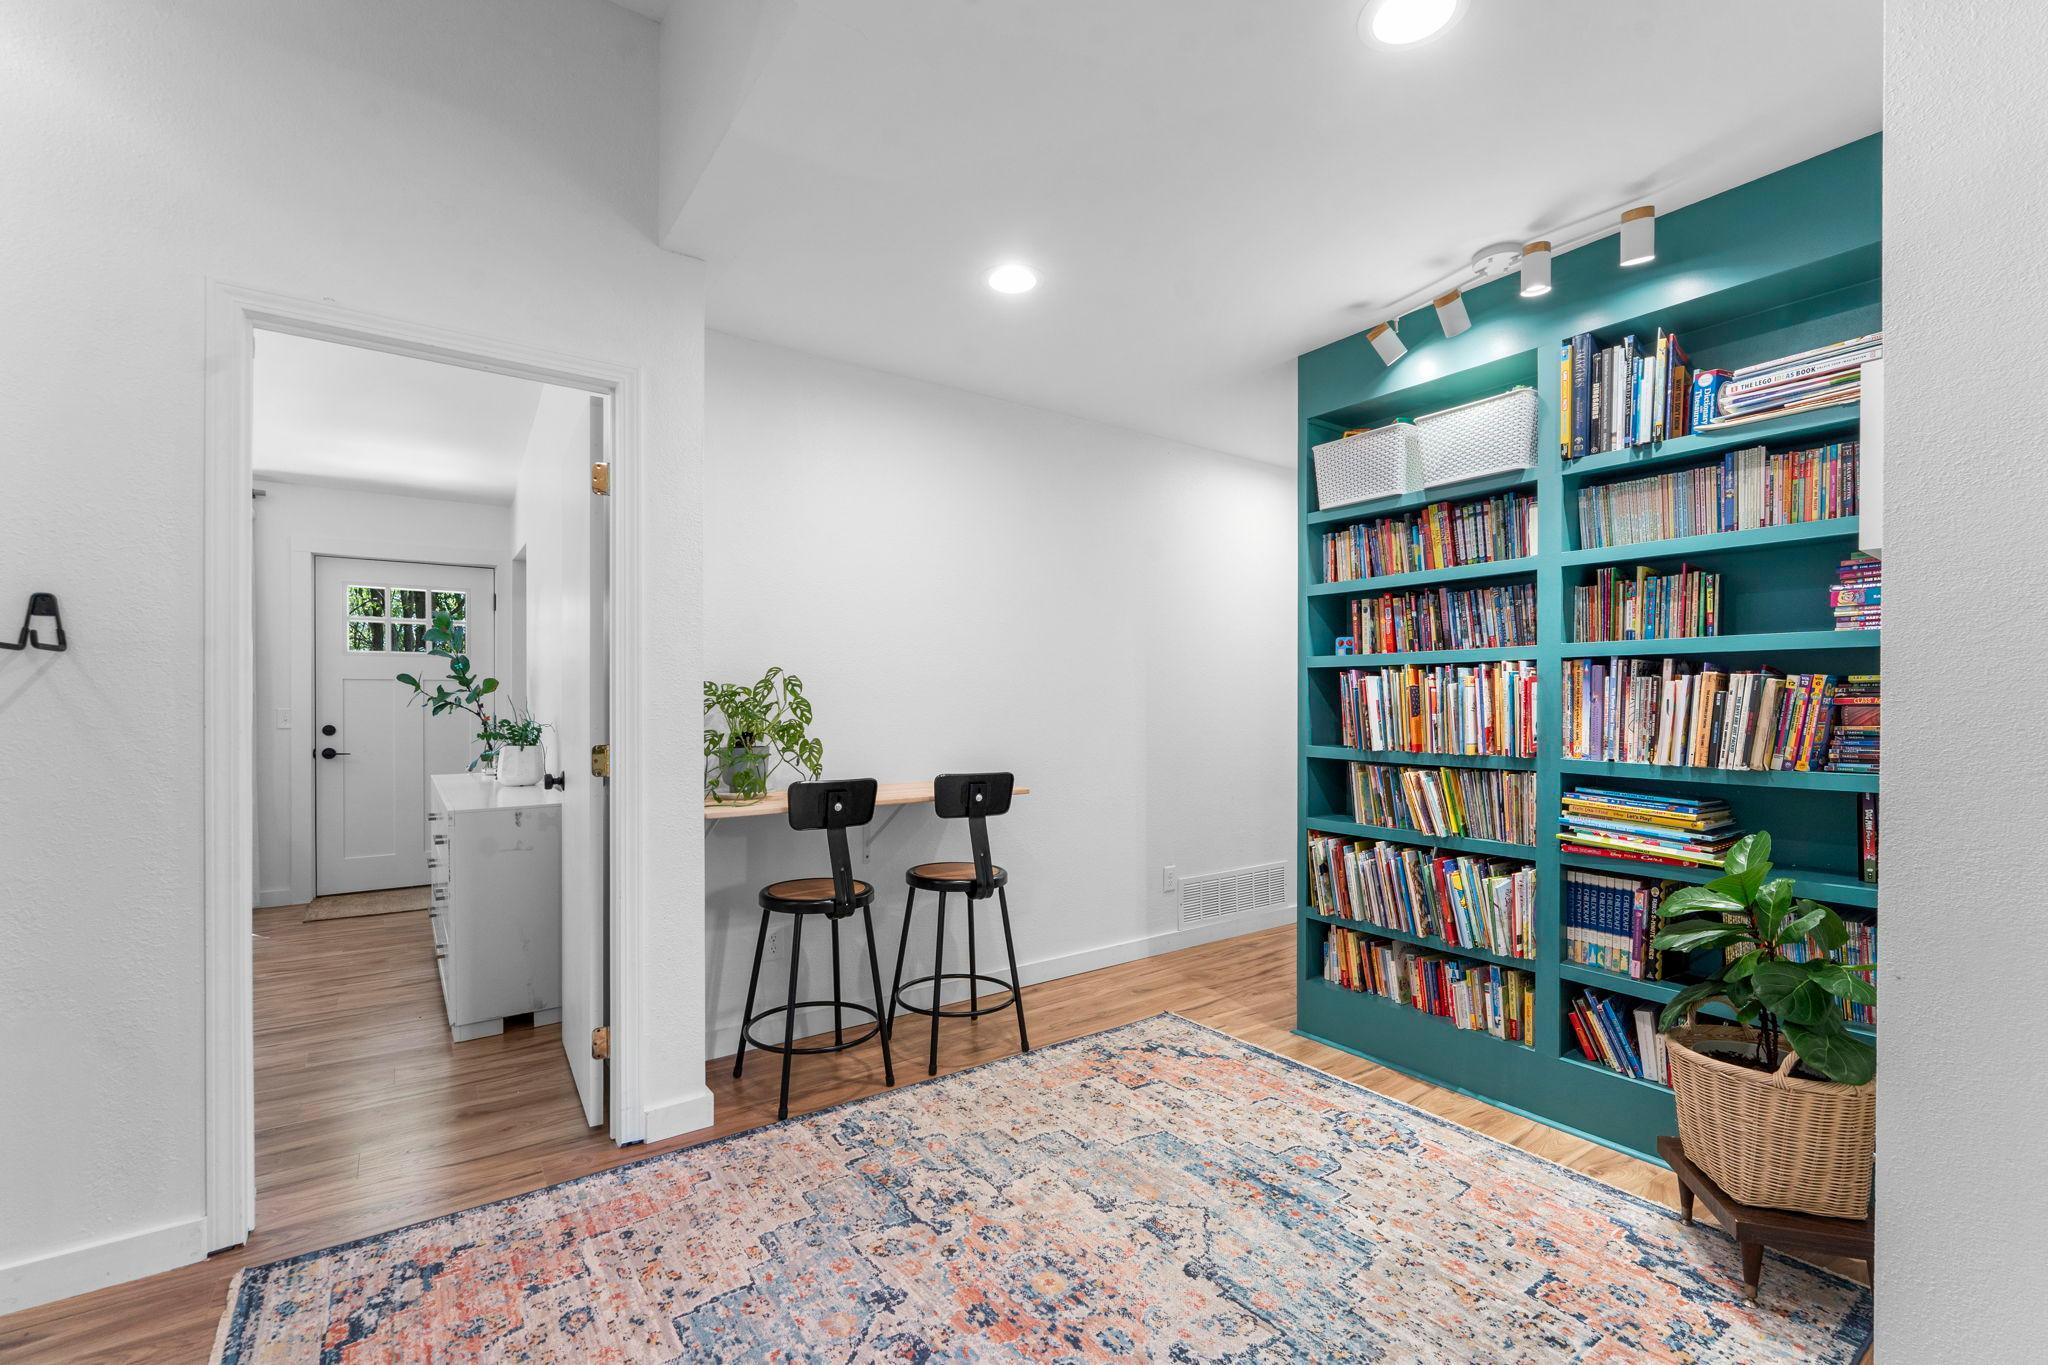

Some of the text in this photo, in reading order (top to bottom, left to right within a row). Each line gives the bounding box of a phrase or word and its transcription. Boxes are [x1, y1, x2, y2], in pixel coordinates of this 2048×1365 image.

[1741, 382, 1753, 390] THE
[1755, 378, 1772, 387] LEGO
[1774, 372, 1794, 382] IDEAS
[1796, 366, 1816, 376] BOOK
[1592, 382, 1600, 420] DINOSAURS
[1694, 389, 1702, 426] Thesaurus
[1702, 388, 1711, 425] Dictionary
[1865, 809, 1873, 820] DOG
[1865, 820, 1873, 831] MAN
